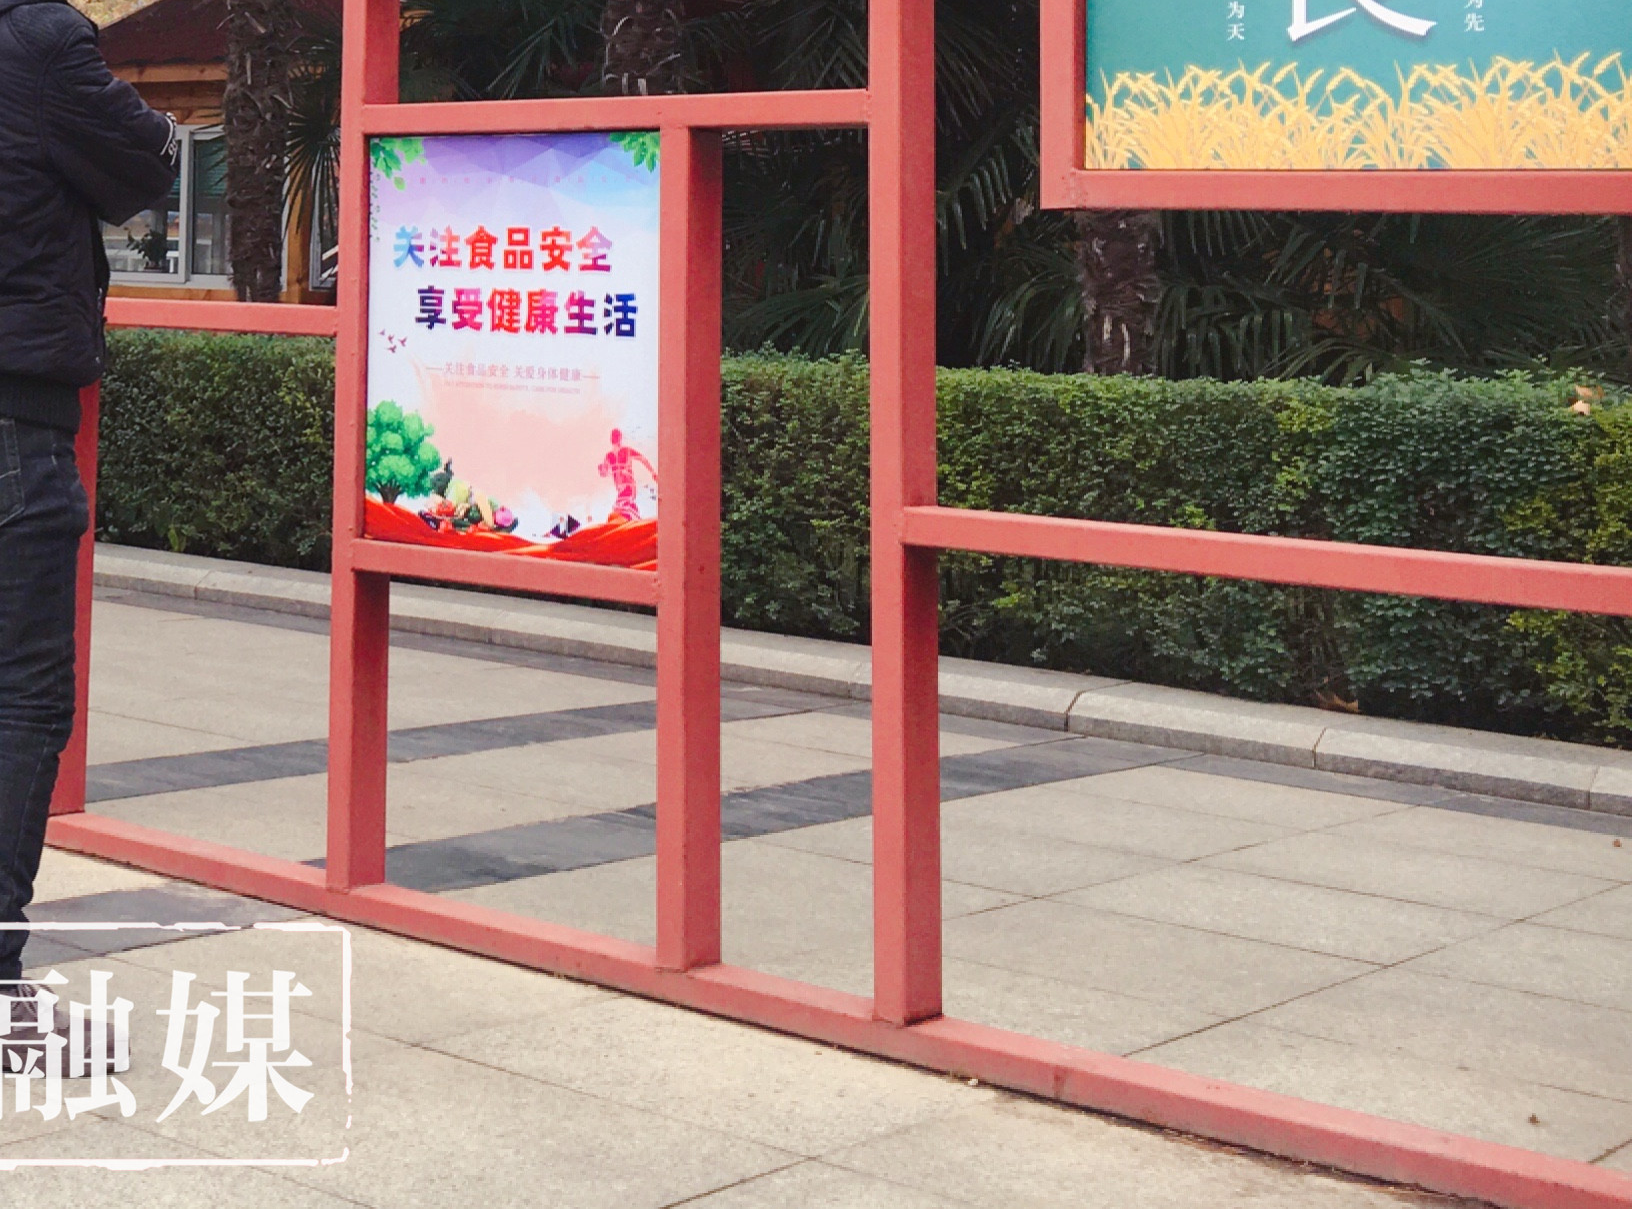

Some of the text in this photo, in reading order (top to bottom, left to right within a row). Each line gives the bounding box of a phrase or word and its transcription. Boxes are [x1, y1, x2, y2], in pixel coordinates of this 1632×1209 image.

[393, 225, 612, 272] 关注食品安全
[415, 285, 638, 337] 享受健康生活
[445, 362, 509, 378] 关注食品安全
